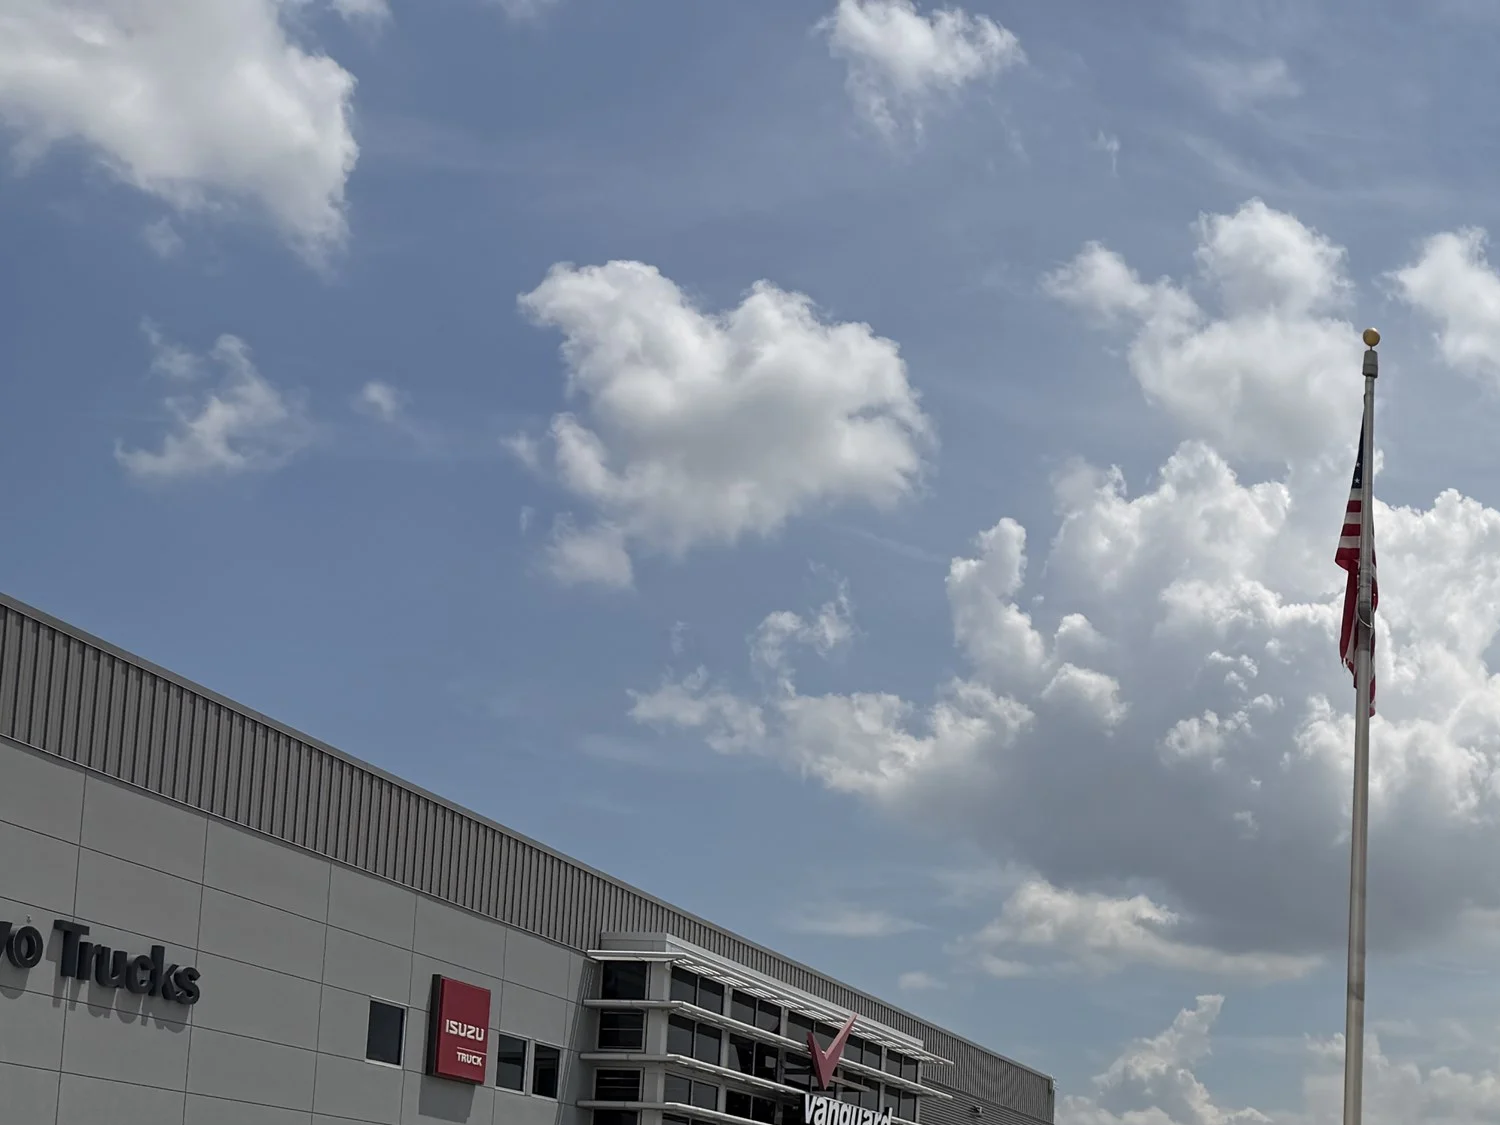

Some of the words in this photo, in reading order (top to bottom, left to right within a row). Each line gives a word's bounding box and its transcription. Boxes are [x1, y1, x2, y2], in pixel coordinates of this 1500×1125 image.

[54, 919, 200, 1004] Trucks
[445, 1019, 485, 1041] ISUZU
[456, 1051, 482, 1066] TRUCK
